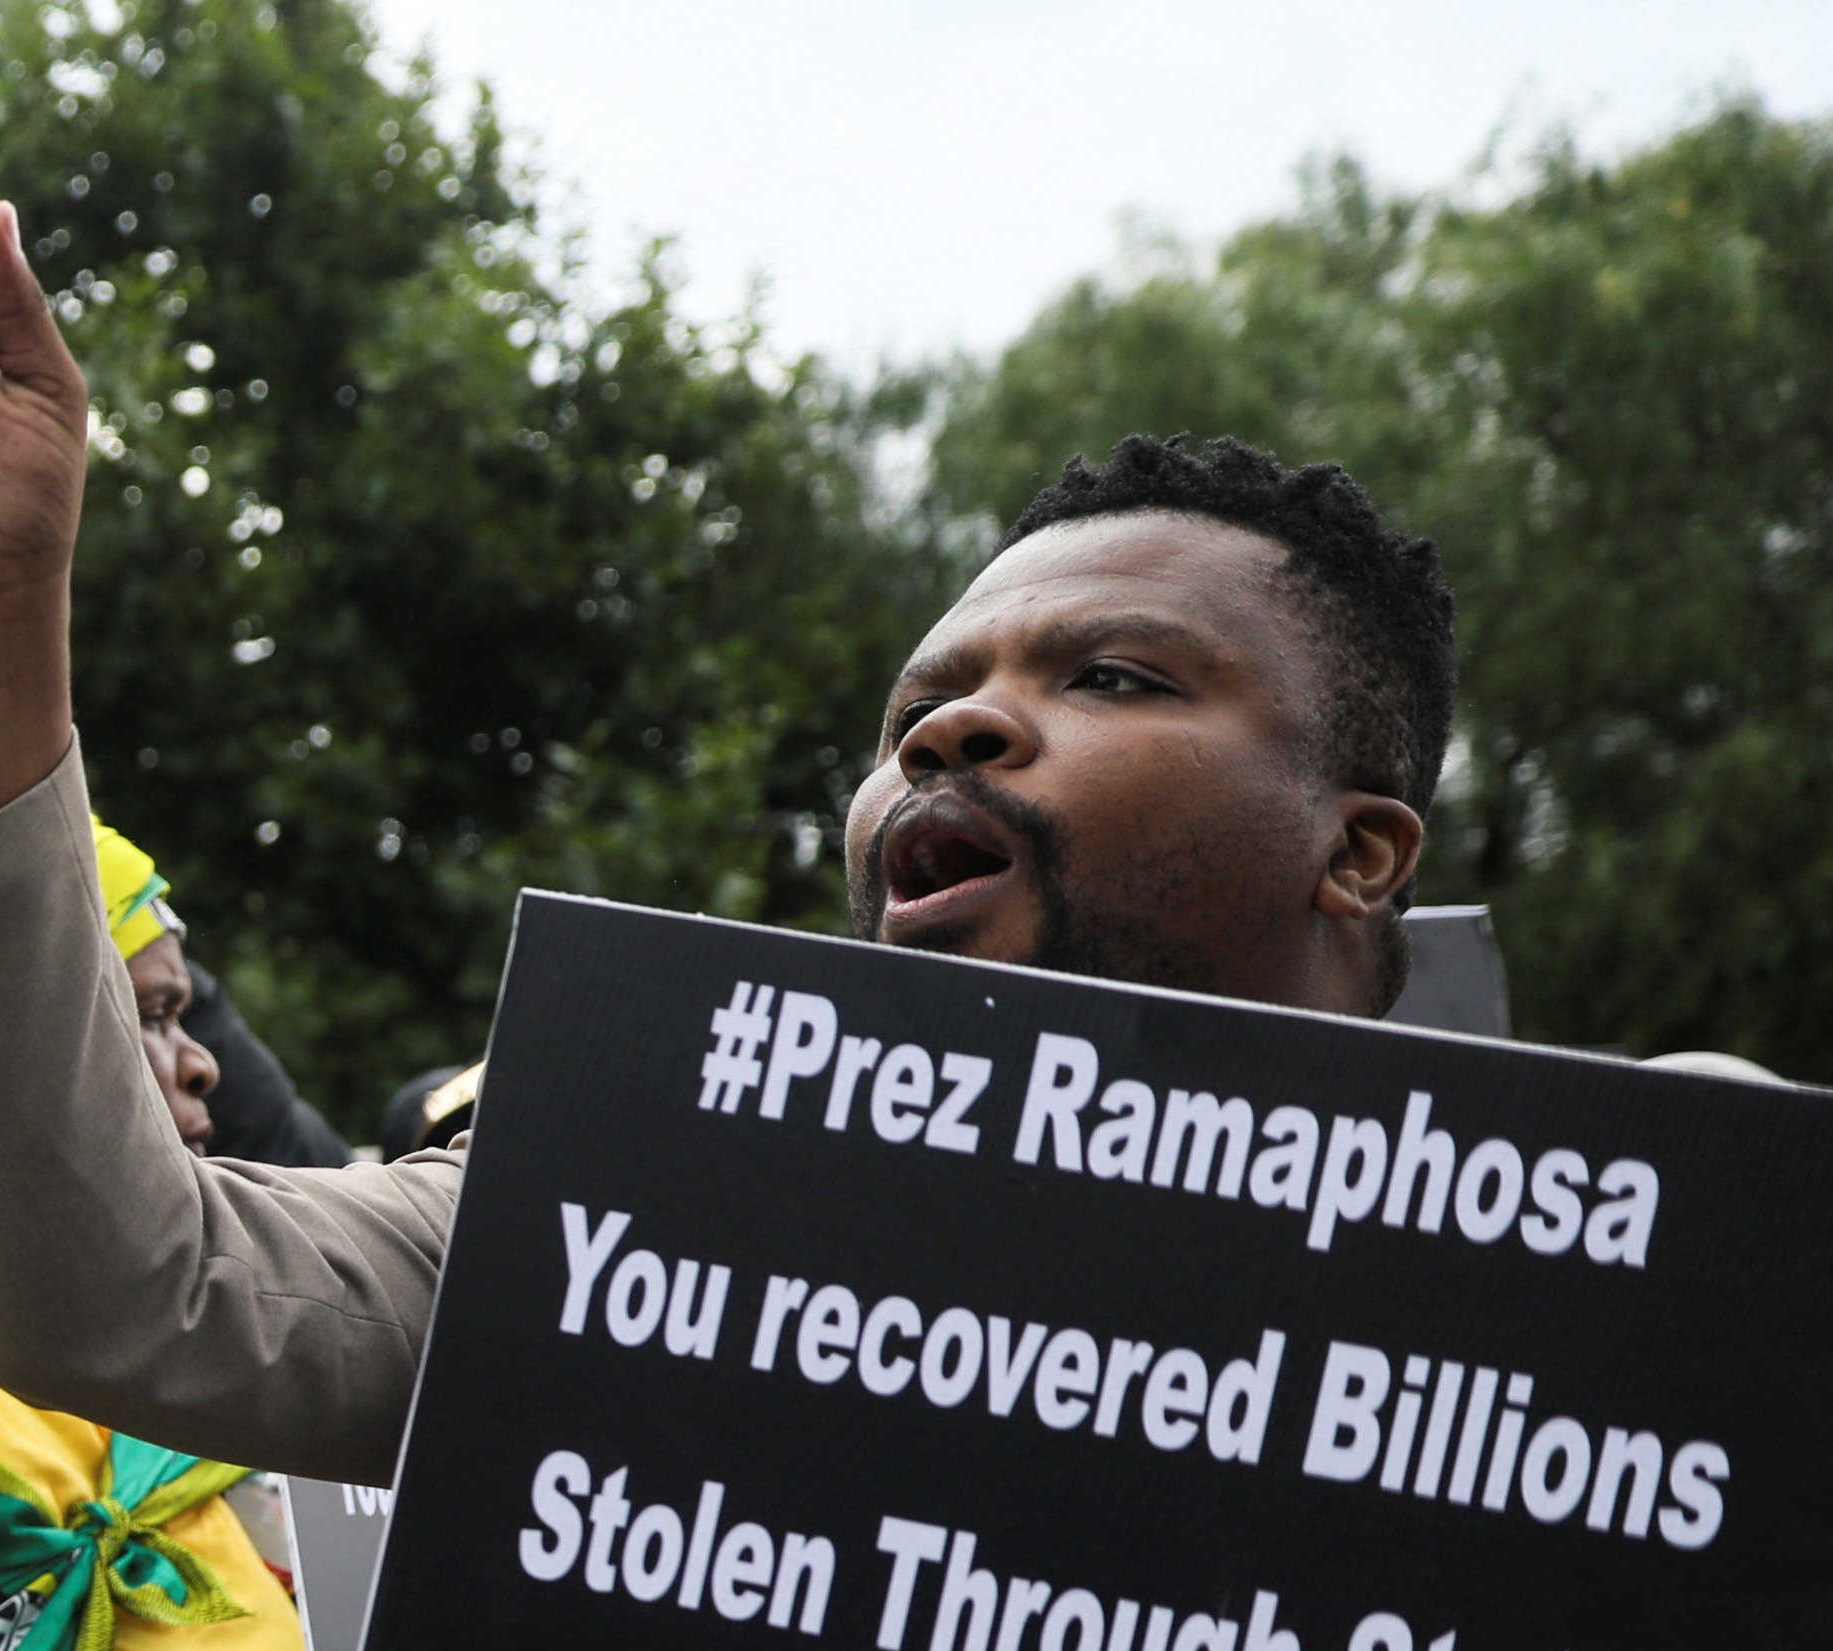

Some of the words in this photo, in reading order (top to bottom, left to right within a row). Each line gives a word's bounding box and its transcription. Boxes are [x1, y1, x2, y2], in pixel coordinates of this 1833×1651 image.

[699, 982, 991, 1152] #Prez
[1015, 1033, 1658, 1265] Ramaphosa
[561, 1203, 730, 1358] You
[752, 1276, 1284, 1462] recovered
[1304, 1343, 1728, 1546] Billions
[520, 1452, 834, 1633] Stolen
